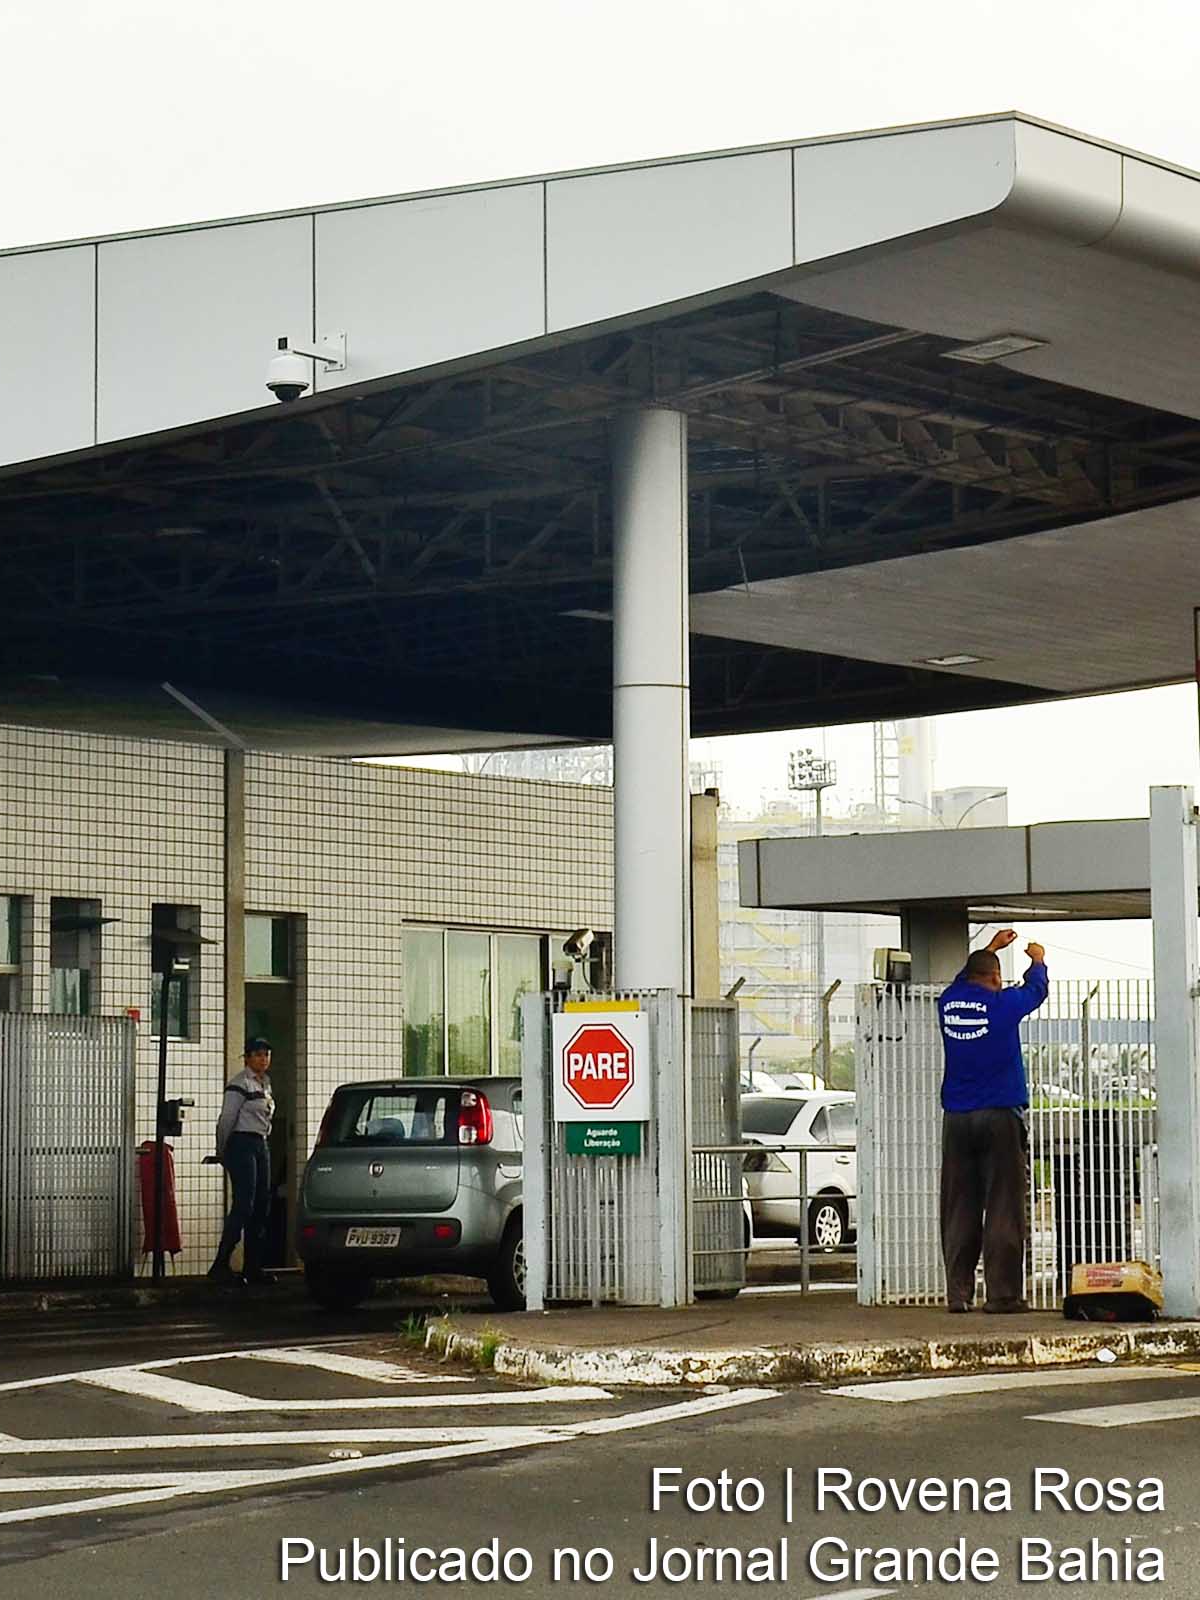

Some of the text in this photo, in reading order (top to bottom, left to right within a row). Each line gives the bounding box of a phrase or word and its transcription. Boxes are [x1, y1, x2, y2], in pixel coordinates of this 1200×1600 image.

[569, 1052, 627, 1080] PARE
[586, 1128, 618, 1137] Aguarde
[584, 1139, 620, 1148] Liberação
